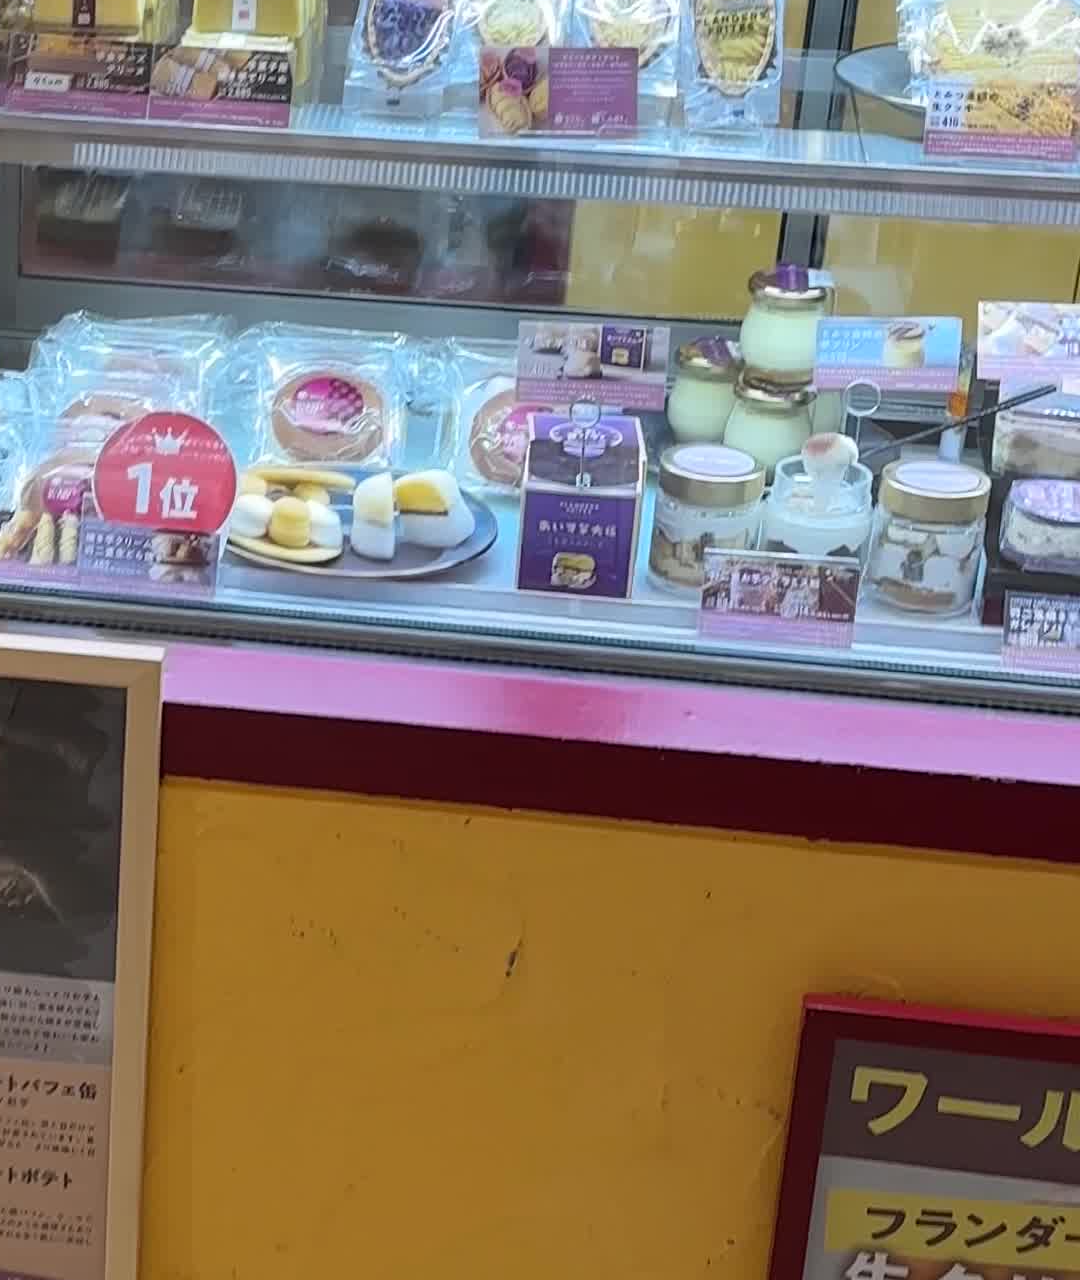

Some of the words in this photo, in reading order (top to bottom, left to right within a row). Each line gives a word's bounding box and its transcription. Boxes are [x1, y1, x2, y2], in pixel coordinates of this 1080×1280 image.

[127, 461, 199, 520] 1位
[849, 1065, 1080, 1152] ワール
